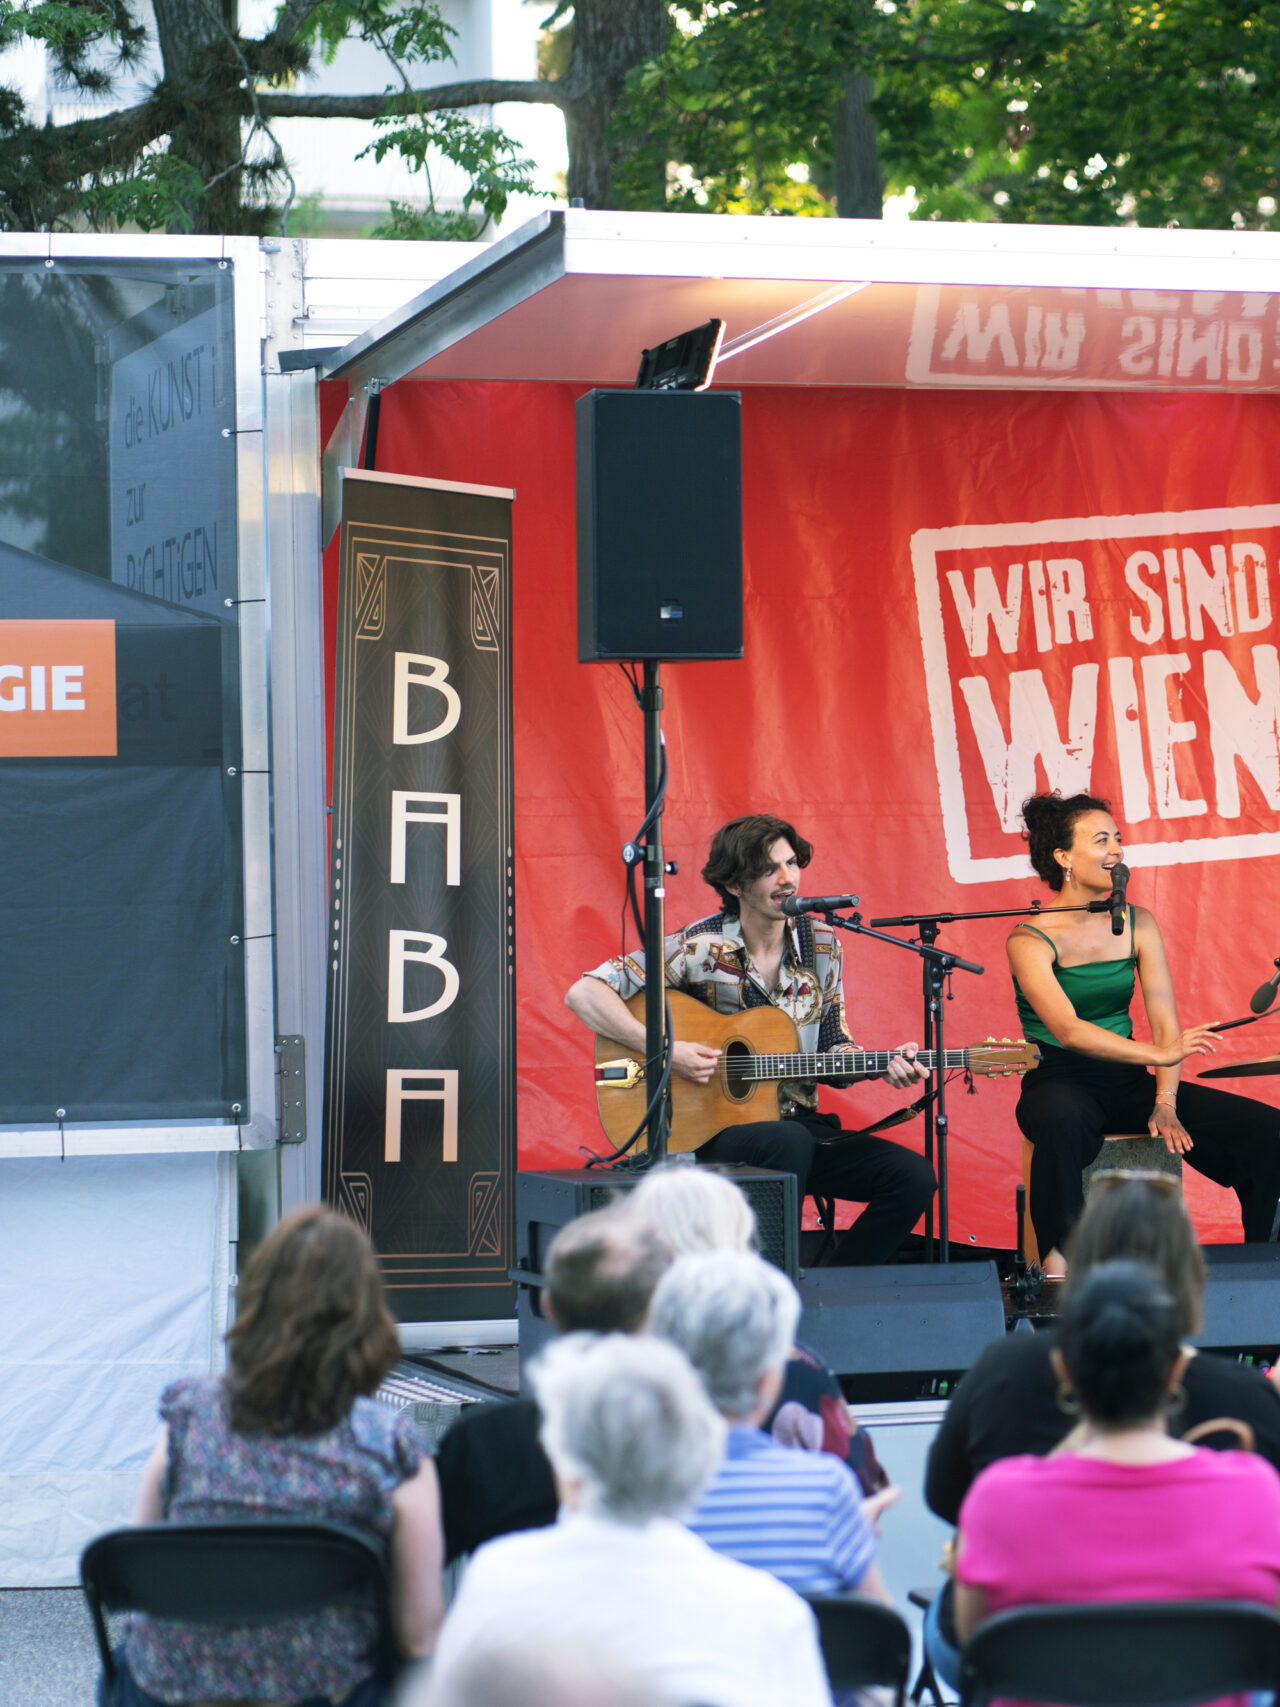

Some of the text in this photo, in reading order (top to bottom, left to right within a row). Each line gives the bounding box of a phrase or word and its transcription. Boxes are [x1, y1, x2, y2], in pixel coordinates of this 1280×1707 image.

[124, 395, 144, 449] die
[147, 344, 205, 440] KUNST
[126, 483, 146, 527] zur
[946, 542, 1273, 657] WIR SIND
[384, 652, 461, 1162] BABA
